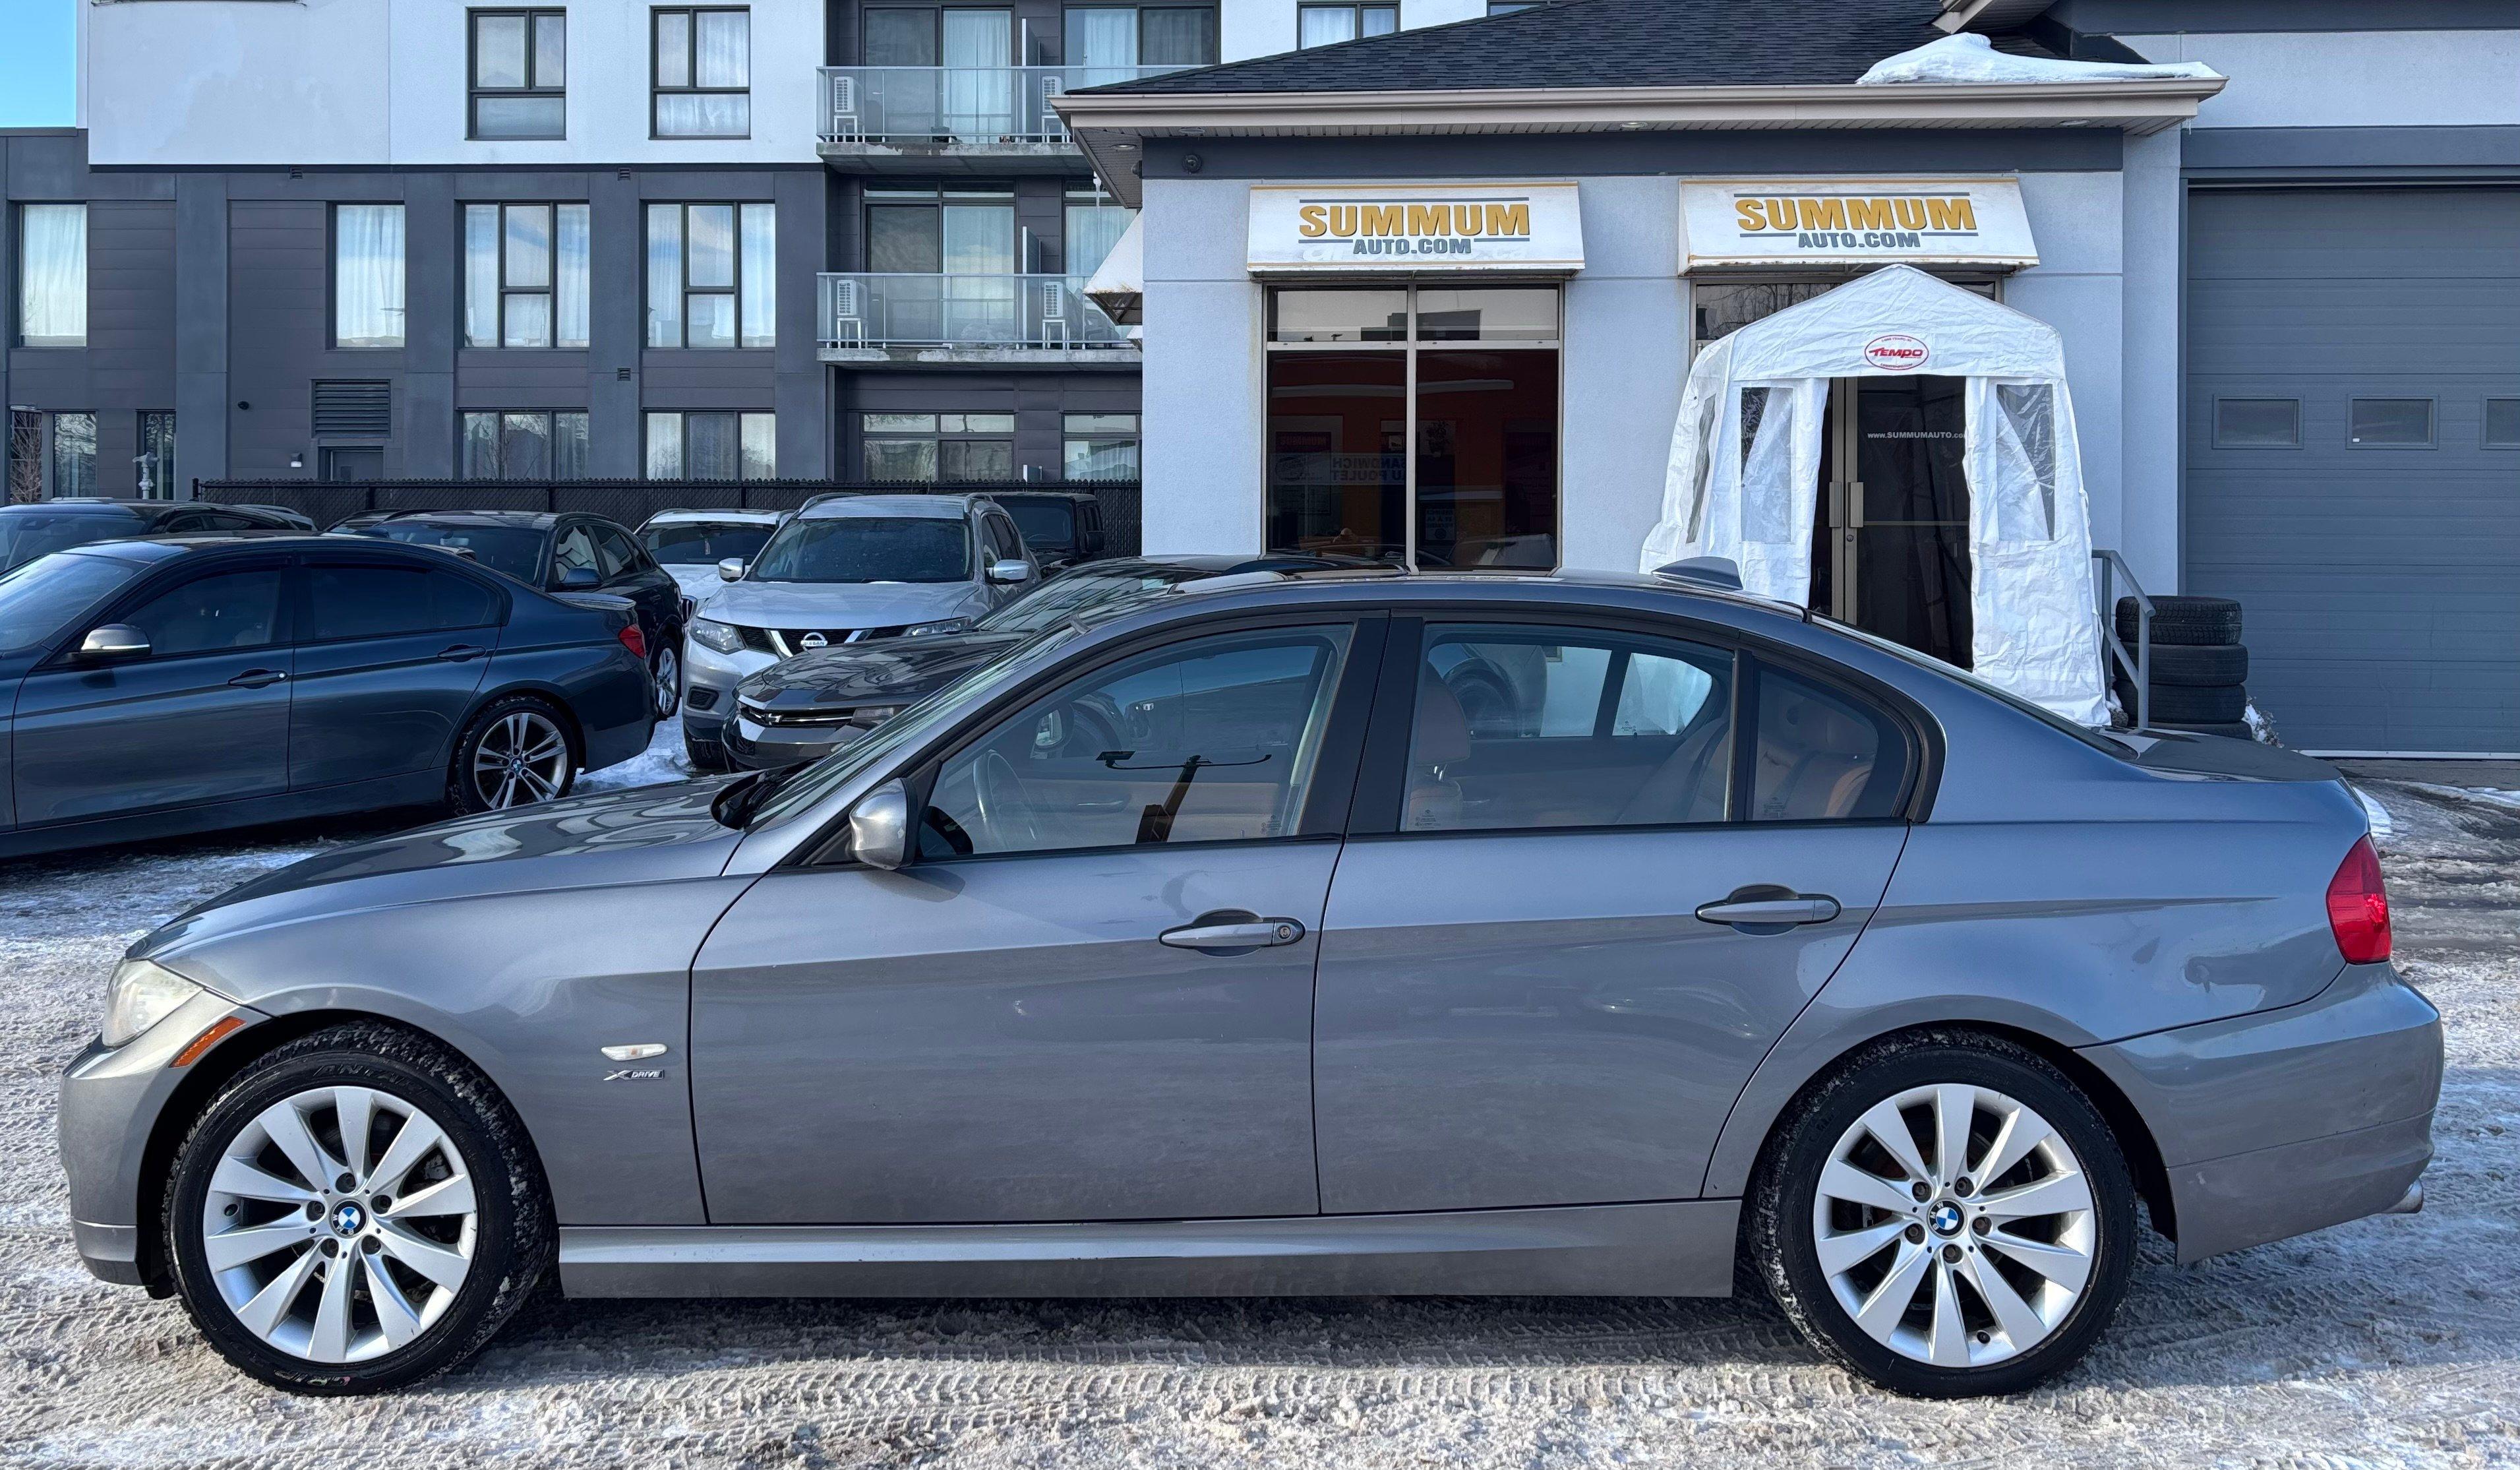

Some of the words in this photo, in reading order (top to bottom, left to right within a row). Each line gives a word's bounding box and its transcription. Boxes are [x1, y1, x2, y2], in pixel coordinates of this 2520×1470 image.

[1299, 204, 1530, 237] SUMMUM
[1735, 199, 1977, 231] SUMMUM
[1352, 238, 1472, 255] AUTO.COM
[1798, 232, 1921, 249] AUTO.COM
[1868, 347, 1923, 358] TEMPO
[332, 1213, 355, 1236] BMW
[1929, 1202, 1944, 1231] BMW
